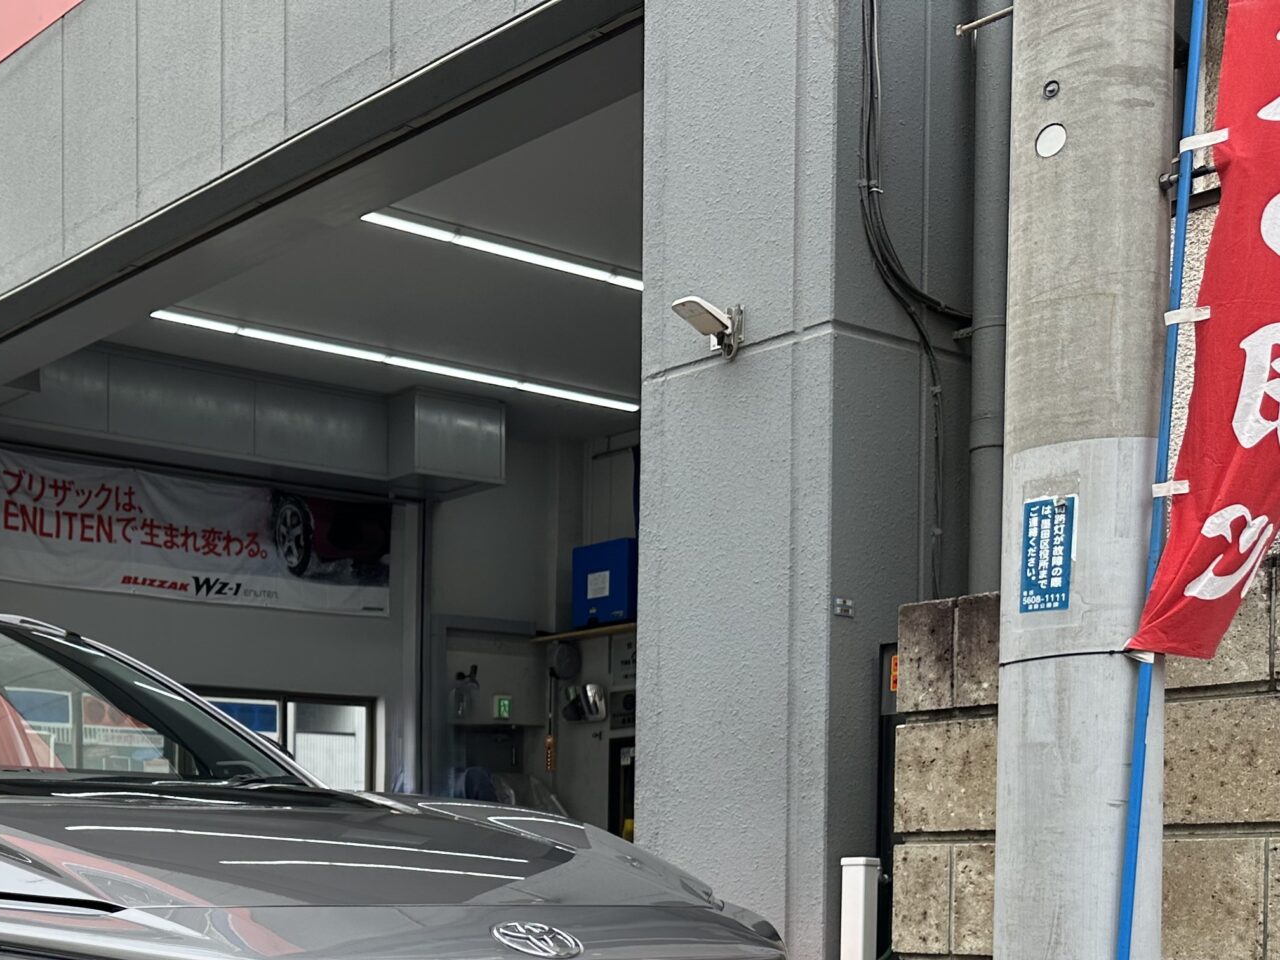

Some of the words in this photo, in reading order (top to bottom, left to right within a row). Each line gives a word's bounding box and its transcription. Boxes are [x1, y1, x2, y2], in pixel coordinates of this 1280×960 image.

[2, 468, 143, 513] ブリザックは、
[1050, 504, 1066, 588] 路灯が故障の際
[121, 575, 190, 592] BLIZZAK
[1022, 593, 1066, 605] 5608-1111
